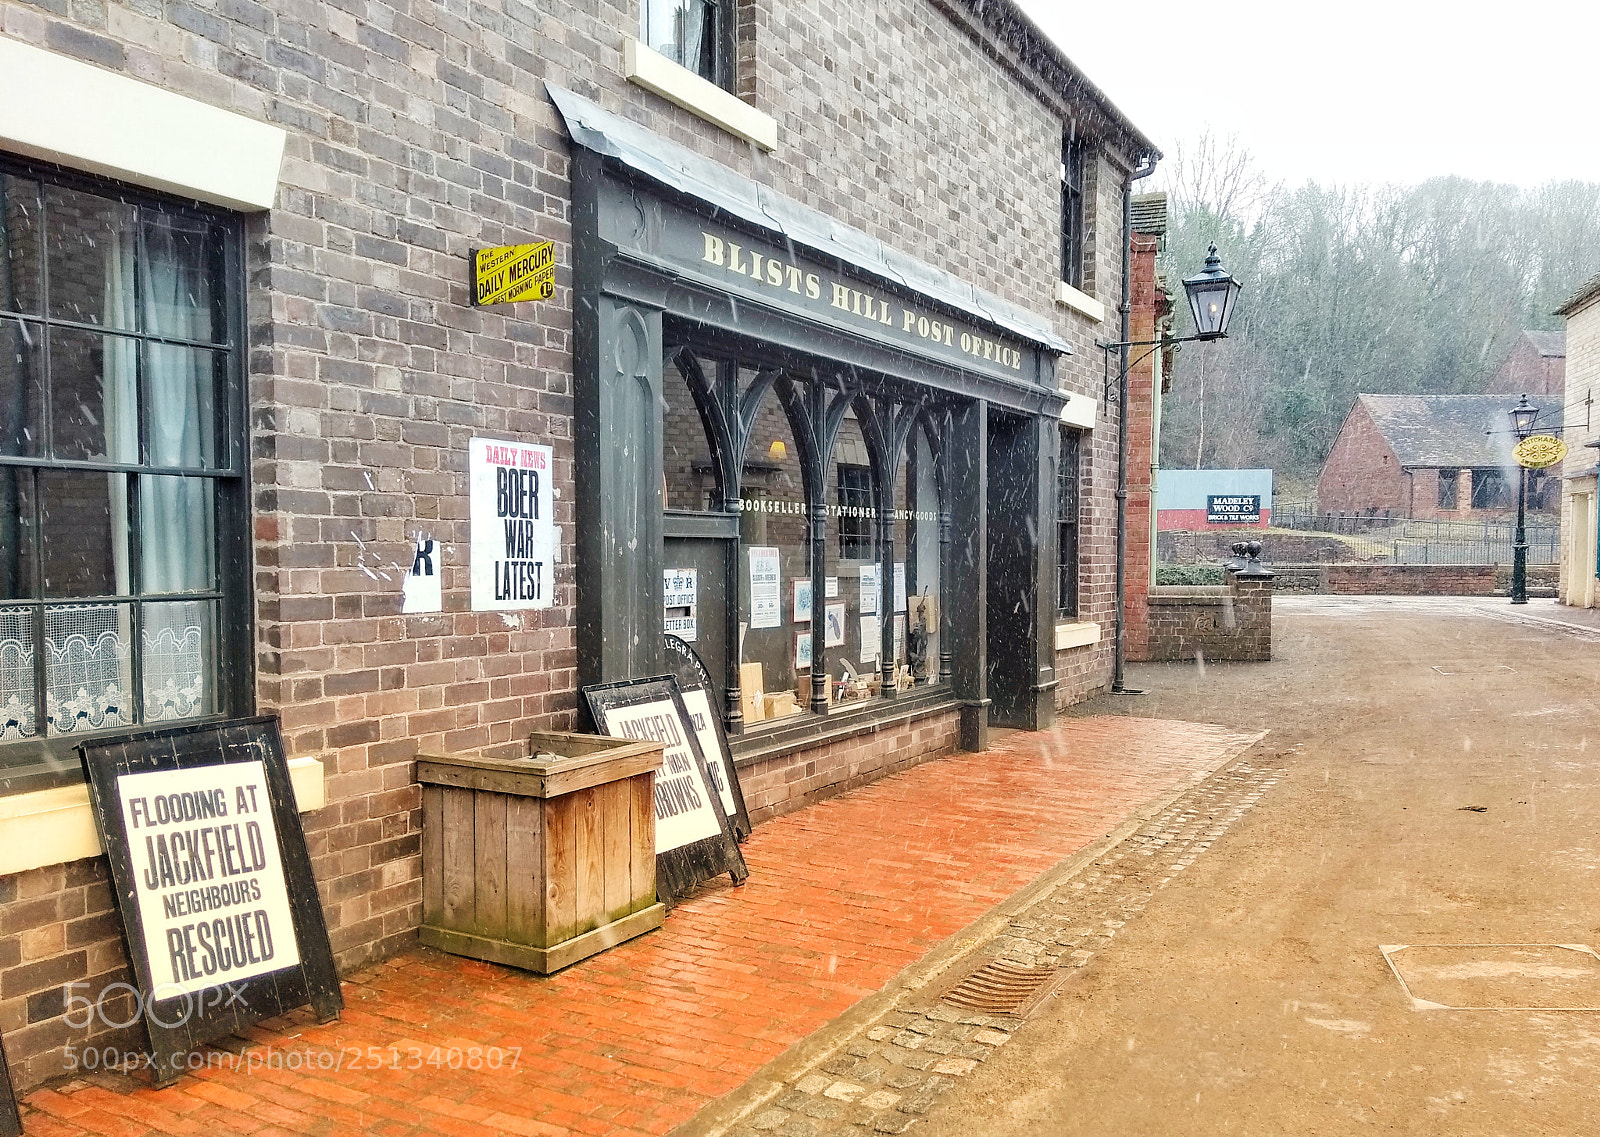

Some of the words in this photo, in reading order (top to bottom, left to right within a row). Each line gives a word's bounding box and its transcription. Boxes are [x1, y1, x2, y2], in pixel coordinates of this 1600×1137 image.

[479, 271, 505, 300] DAILY
[509, 245, 554, 283] MERCURY
[480, 250, 494, 263] THE
[480, 249, 515, 273] WESTERN
[508, 280, 533, 299] MORNING
[534, 267, 554, 286] PAPER
[701, 231, 820, 300] BLISTS
[830, 282, 892, 326] HILL
[902, 309, 954, 347] POST
[960, 332, 1021, 370] OFFICE
[486, 445, 518, 467] DAILY
[520, 450, 546, 469] NEWS
[497, 466, 539, 520] BOER
[739, 499, 807, 515] BOOKSELLER
[825, 505, 877, 519] STATIONER
[893, 510, 913, 521] ANCY
[915, 512, 937, 521] GOODS
[1213, 497, 1254, 505] MADELEY
[1213, 504, 1241, 512] WOOD
[504, 519, 534, 559] WAR
[495, 561, 543, 601] LATEST
[664, 578, 671, 589] V
[685, 577, 693, 588] R
[663, 595, 676, 606] OST
[677, 594, 695, 605] OFFICE
[129, 788, 228, 829] FLOODING
[235, 784, 258, 814] AT
[143, 820, 267, 891] JACKFIELD
[162, 877, 261, 919] NEIGHBOURS
[166, 909, 275, 984] RESCUED
